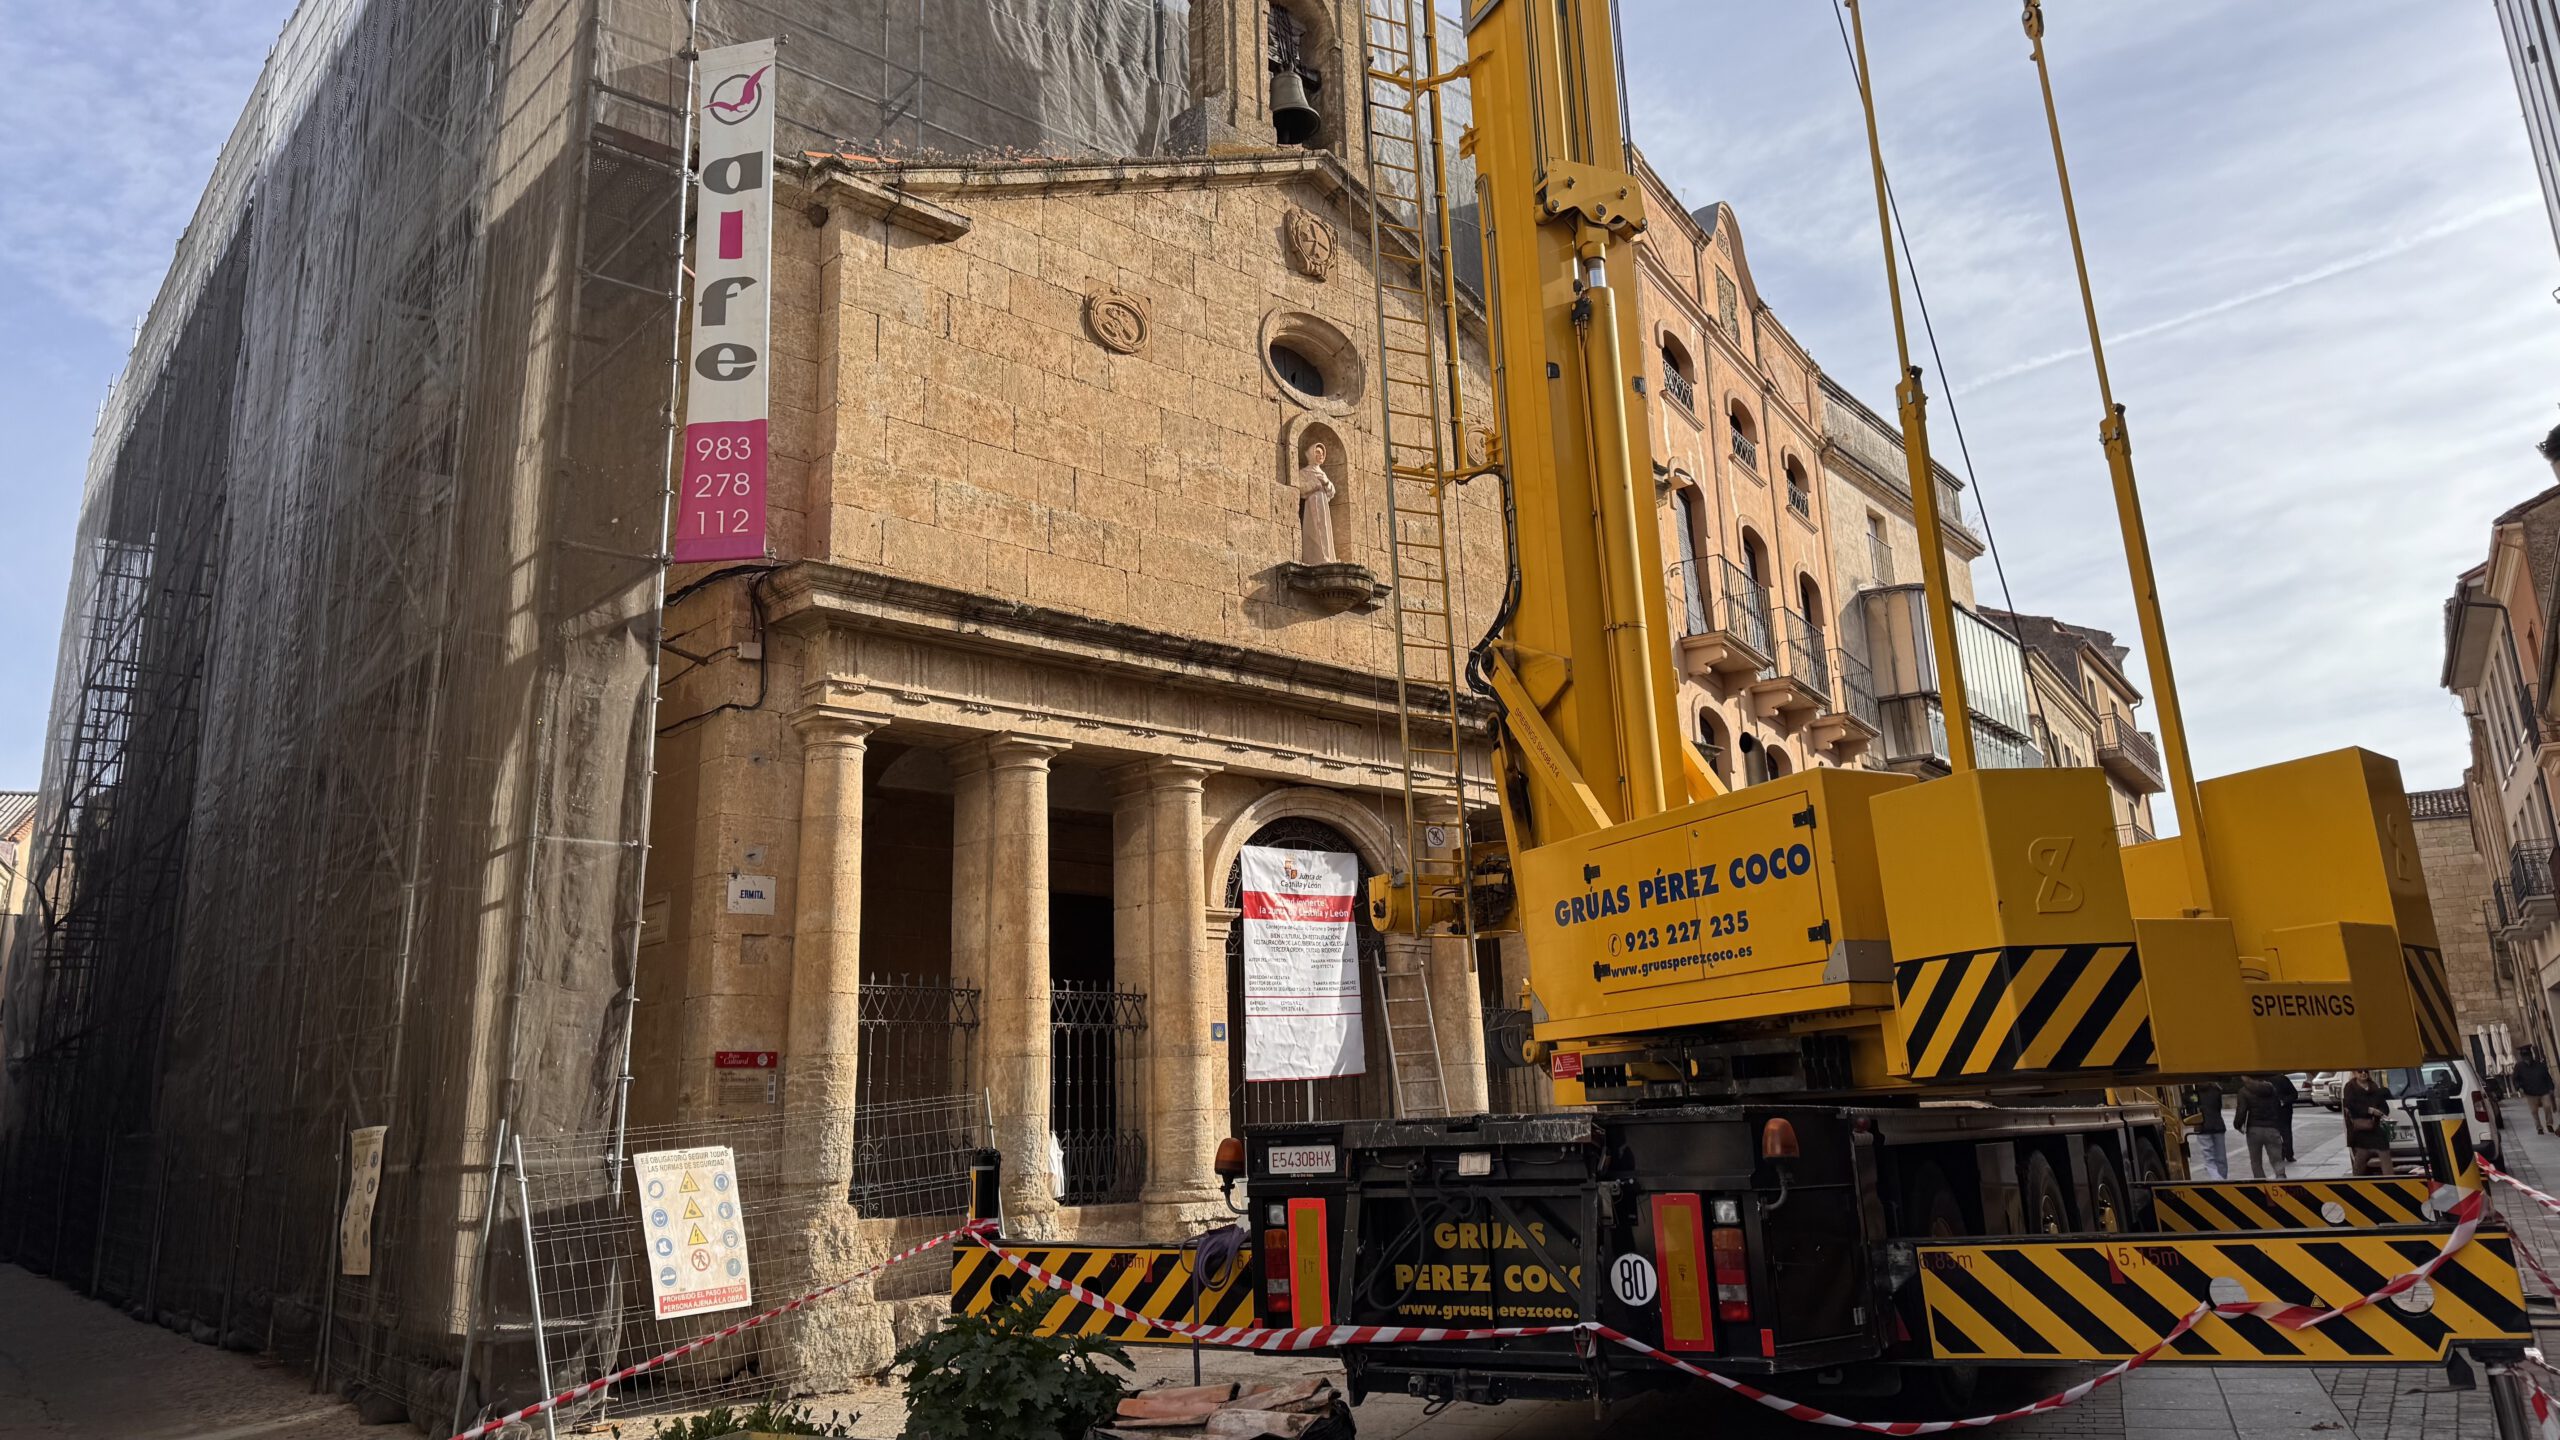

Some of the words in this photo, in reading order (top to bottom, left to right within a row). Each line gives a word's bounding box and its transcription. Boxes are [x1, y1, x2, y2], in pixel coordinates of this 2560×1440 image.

[695, 436, 752, 461] 983
[694, 472, 751, 498] 278
[696, 509, 749, 535] 112
[1554, 885, 1630, 927] GRÚAS
[1638, 867, 1719, 909] PÉREZ
[1728, 842, 1811, 889] COCO
[1330, 909, 1349, 918] León
[1625, 927, 1660, 953] 923
[1666, 919, 1701, 945] 227
[1709, 910, 1749, 938] 235
[1611, 946, 1753, 978] www.gruasperezcoco.es
[2251, 994, 2355, 1017] SPIERINGS
[647, 1165, 659, 1173] LAS
[659, 1163, 683, 1172] NORMAS
[692, 1159, 725, 1169] SEGURIDAD
[649, 1154, 687, 1164] OBLIGATORIO
[688, 1152, 709, 1160] SEGUIR
[710, 1150, 729, 1158] TODAS
[1272, 1151, 1332, 1169] E5430BHX
[2118, 1247, 2179, 1269] 5,15m
[1619, 1259, 1648, 1301] 80
[662, 1292, 696, 1304] PROHIBIDO
[705, 1289, 721, 1297] PASO
[727, 1285, 744, 1294] TODA
[663, 1302, 693, 1312] PERSONA
[693, 1298, 713, 1308] AJENA
[718, 1295, 727, 1304] LA
[727, 1293, 744, 1303] OBRA
